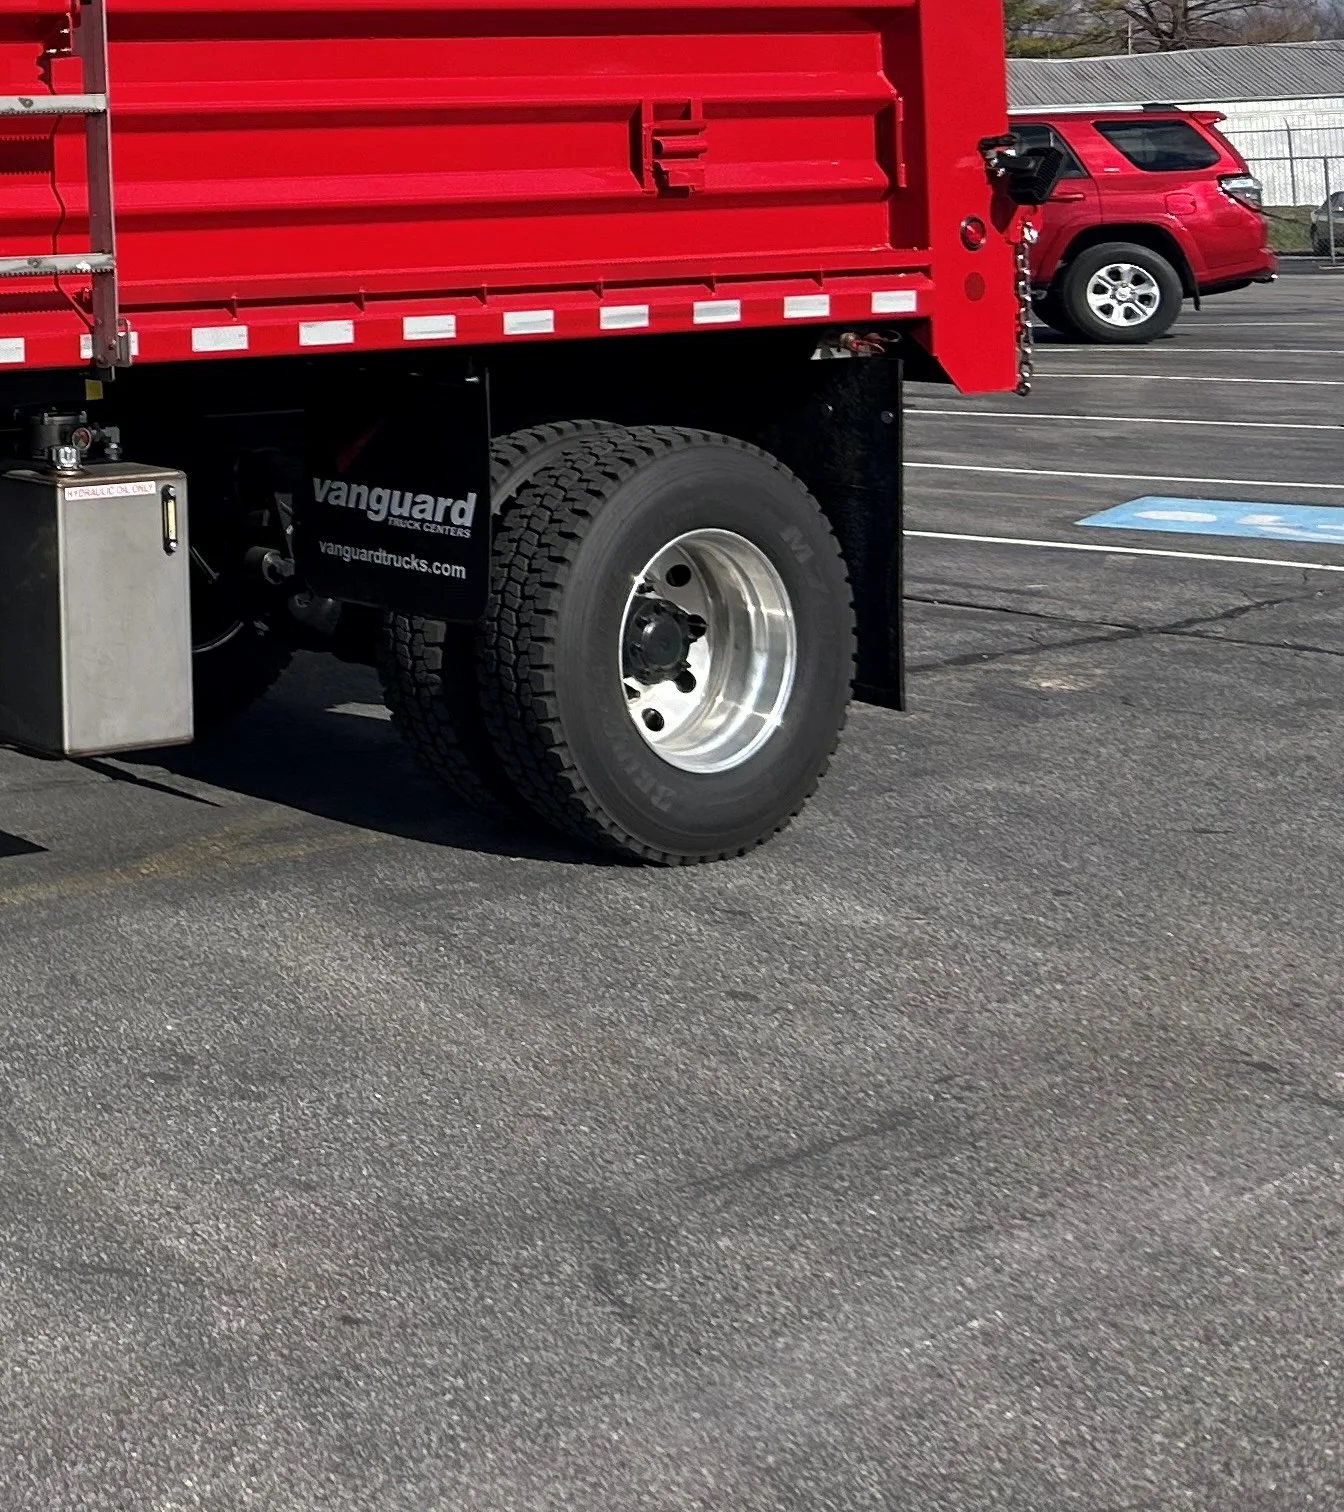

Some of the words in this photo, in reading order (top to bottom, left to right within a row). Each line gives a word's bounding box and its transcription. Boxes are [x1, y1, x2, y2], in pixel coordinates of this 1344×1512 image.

[312, 476, 478, 528] vanguard
[387, 516, 422, 531] TRUCK
[423, 521, 472, 539] CENTERS
[318, 540, 467, 580] vanguardtrucks.com
